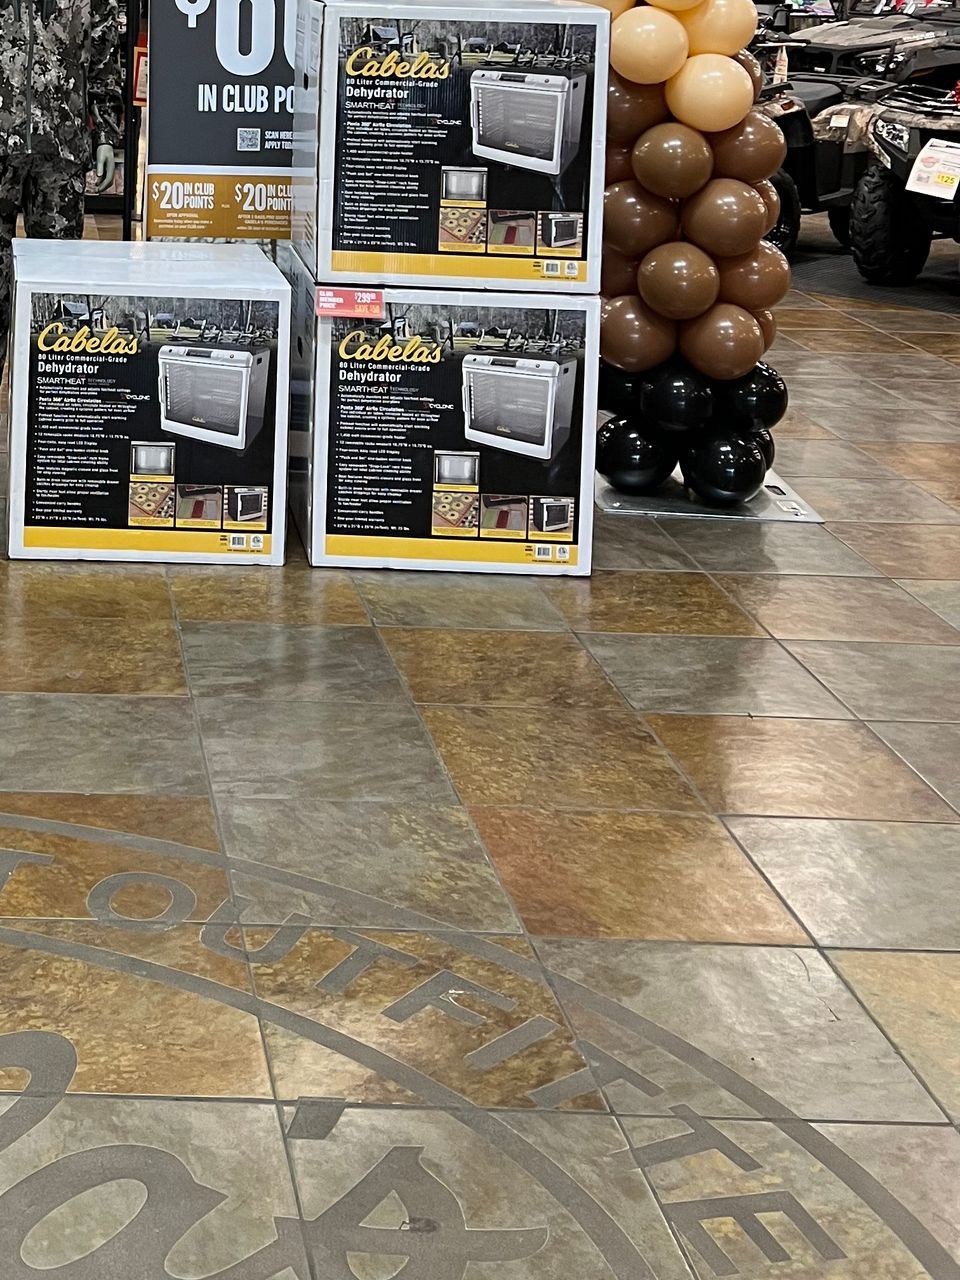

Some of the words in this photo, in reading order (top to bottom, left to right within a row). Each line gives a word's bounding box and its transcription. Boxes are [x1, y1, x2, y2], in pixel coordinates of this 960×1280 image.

[345, 47, 449, 79] Cabela's
[357, 78, 373, 86] Liter
[375, 79, 438, 88] Commercial-Grade
[198, 84, 217, 112] IN
[222, 85, 268, 113] CLUB
[346, 87, 409, 99] Dehydrator
[345, 101, 396, 110] SMARTHEAT
[264, 131, 280, 139] SCAN
[152, 181, 184, 209] $20
[184, 182, 193, 195] IN
[194, 183, 215, 196] CLUB
[235, 183, 268, 211] $20
[267, 185, 276, 197] IN
[184, 195, 214, 209] POINTS
[37, 322, 139, 355] Cabela's
[338, 330, 442, 364] Cabela's
[48, 353, 64, 361] Liter
[66, 354, 127, 363] Commercial-Grade
[38, 361, 99, 375] Dehydrator
[368, 362, 431, 371] Commercial-Grade
[36, 376, 86, 385] SMARTHEAT
[339, 370, 402, 383] Dehydrator
[338, 385, 388, 394] SMARTHEAT
[86, 871, 849, 1280] OUTFITTE
